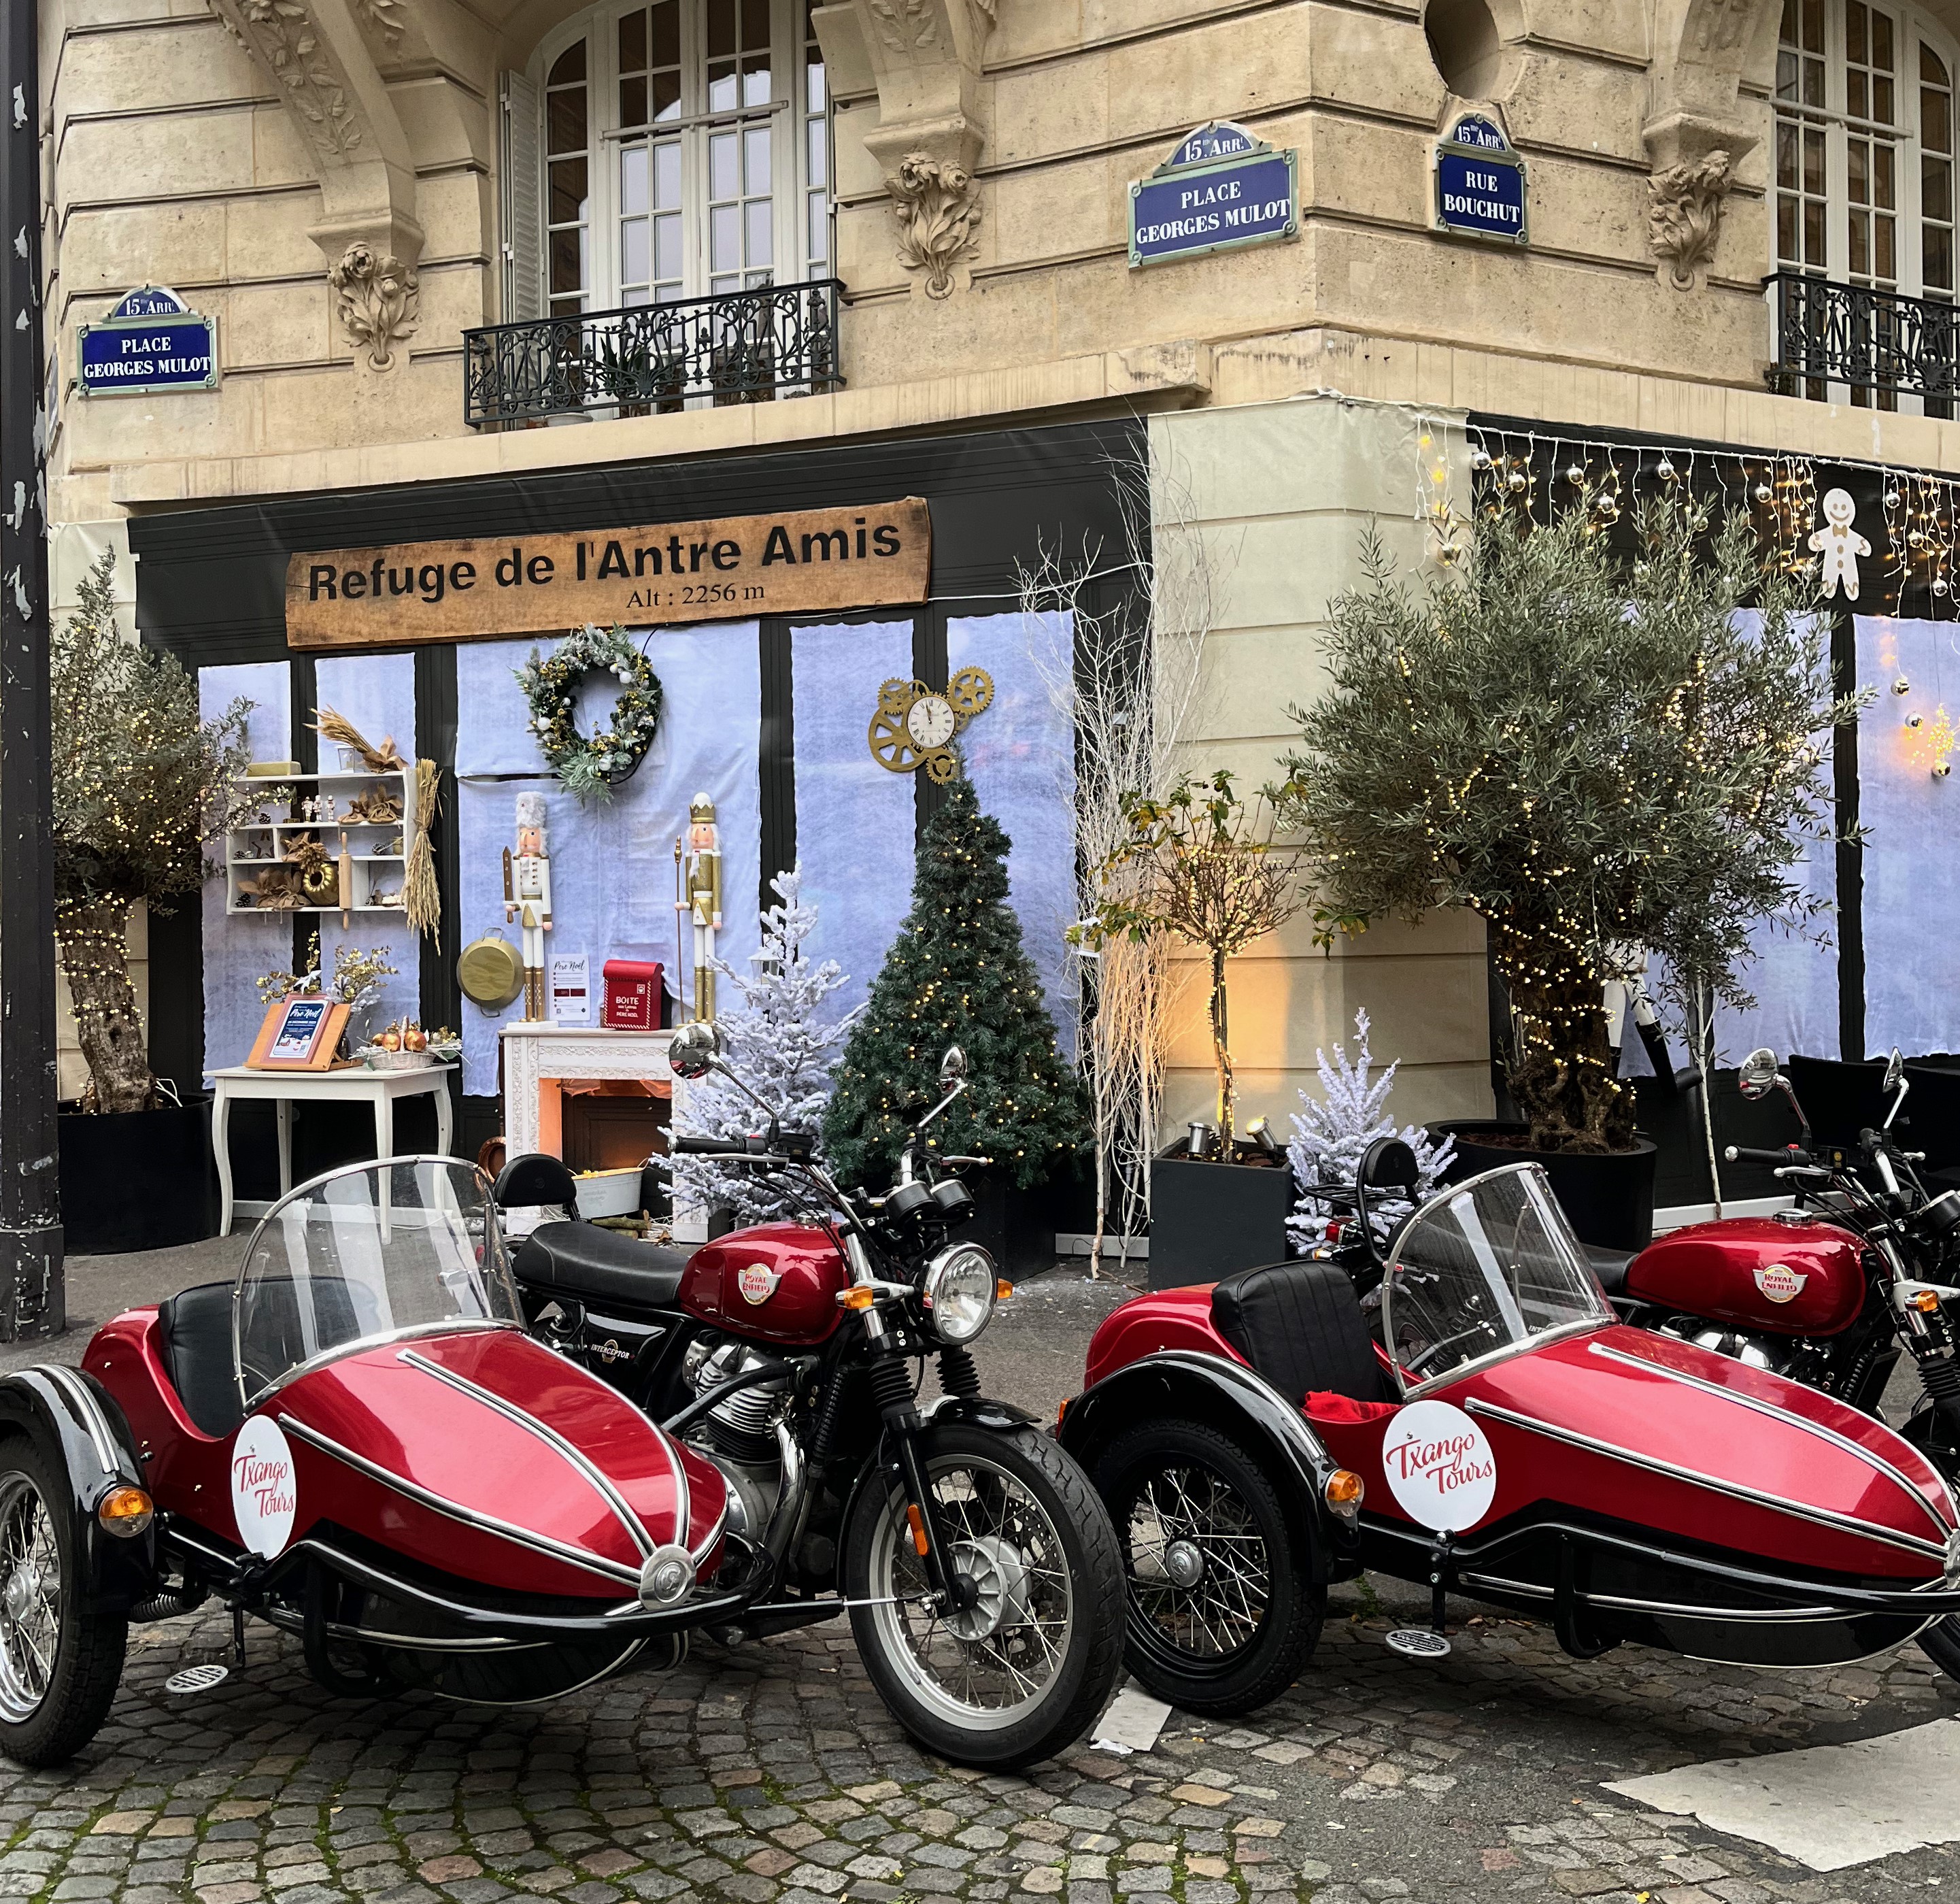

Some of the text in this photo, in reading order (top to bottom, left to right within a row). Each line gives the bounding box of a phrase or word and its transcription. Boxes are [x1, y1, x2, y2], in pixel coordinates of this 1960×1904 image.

[1466, 171, 1498, 192] RUE
[1181, 181, 1241, 209] PLACE
[1444, 193, 1520, 222] BOUCHUT
[1136, 199, 1290, 244] GEORGES MULOT
[121, 337, 171, 354] PLACE
[84, 357, 211, 378] GEORGES MULOT
[309, 517, 900, 603] Refuge de l'Antre Amis
[627, 589, 660, 608] Alt
[682, 583, 736, 604] 2256
[743, 586, 765, 599] m
[615, 996, 639, 1005] BOITE
[743, 1283, 770, 1293] ENFIELD
[745, 1273, 767, 1283] ROYAL
[1762, 1282, 1797, 1292] ENFIELD
[1764, 1274, 1793, 1283] ROYAL
[590, 1343, 630, 1358] INTERCEPTOR
[1386, 1433, 1474, 1480] Txango
[234, 1454, 288, 1496] Txango
[1426, 1460, 1493, 1494] Tours
[254, 1488, 294, 1518] Tours
